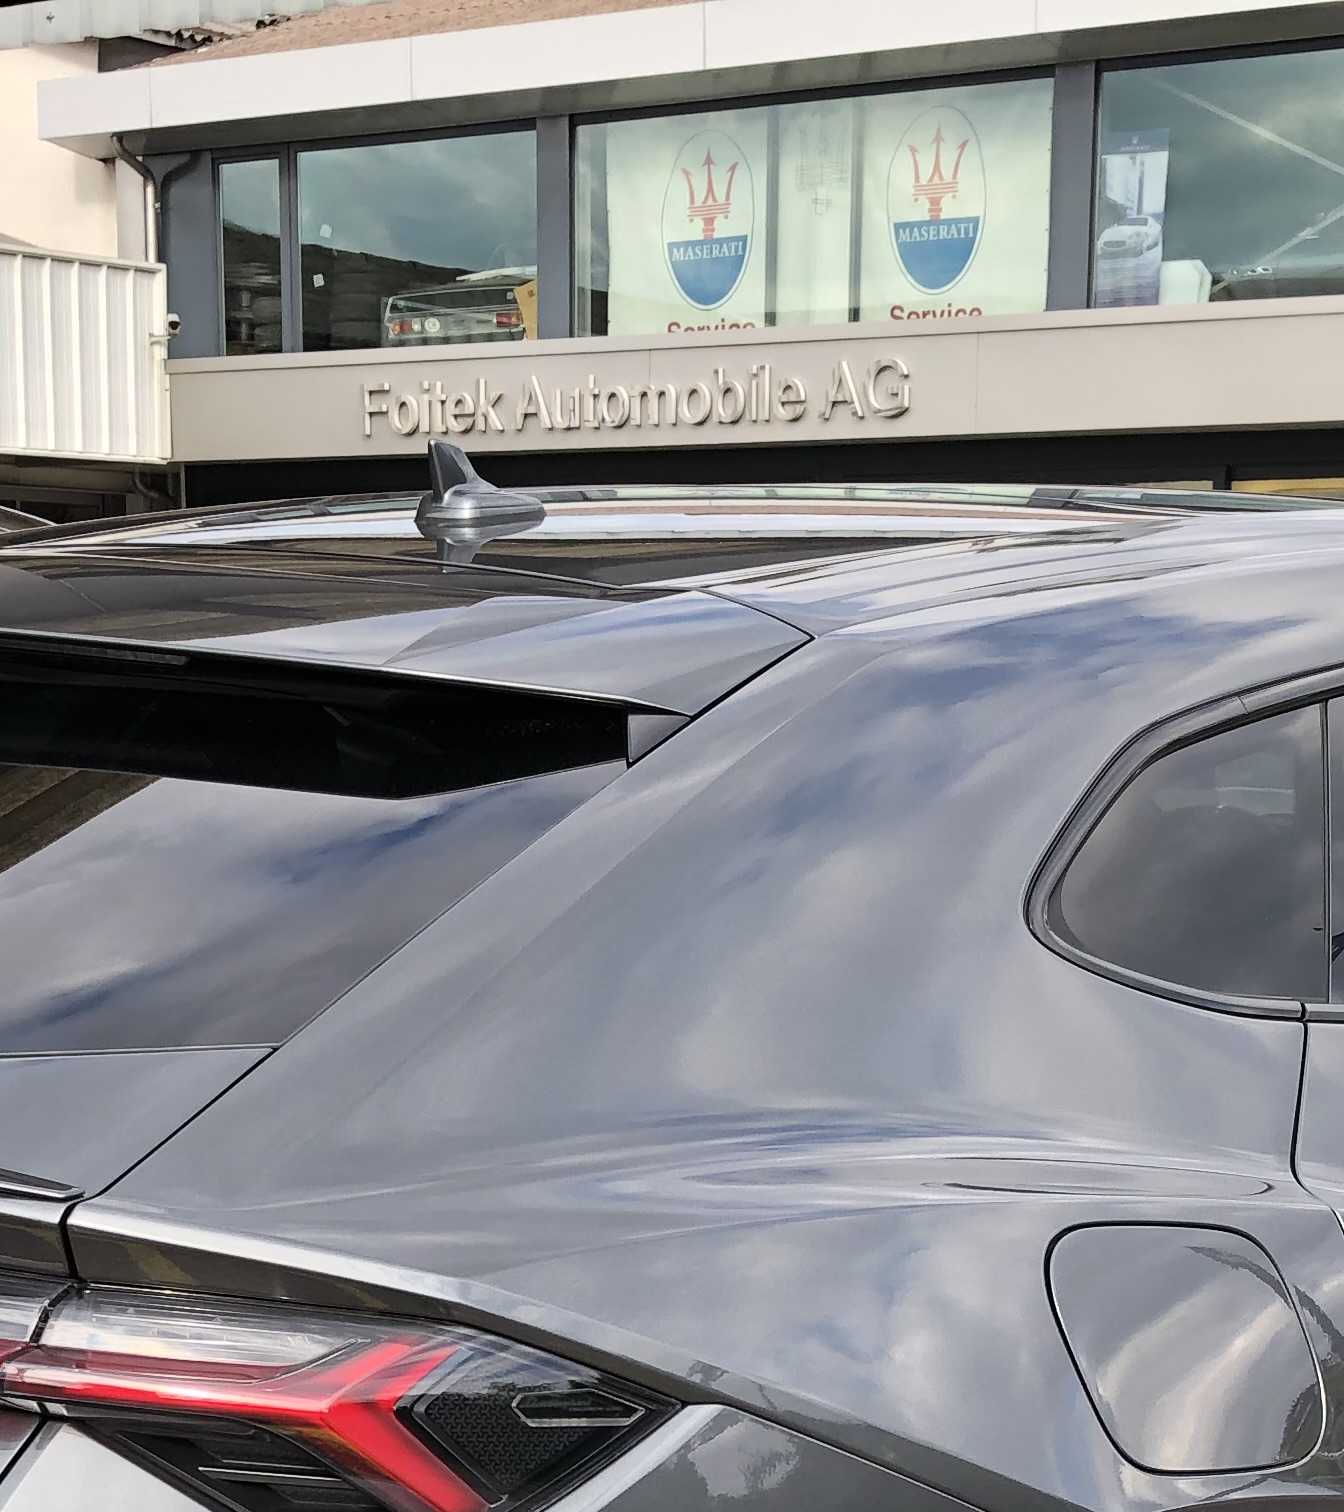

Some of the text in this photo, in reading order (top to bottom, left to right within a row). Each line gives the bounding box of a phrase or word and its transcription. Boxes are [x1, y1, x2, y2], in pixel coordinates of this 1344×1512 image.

[898, 223, 974, 243] MASERATI
[672, 241, 744, 261] MASERATI
[362, 358, 911, 436] Foitek Automobile AG
